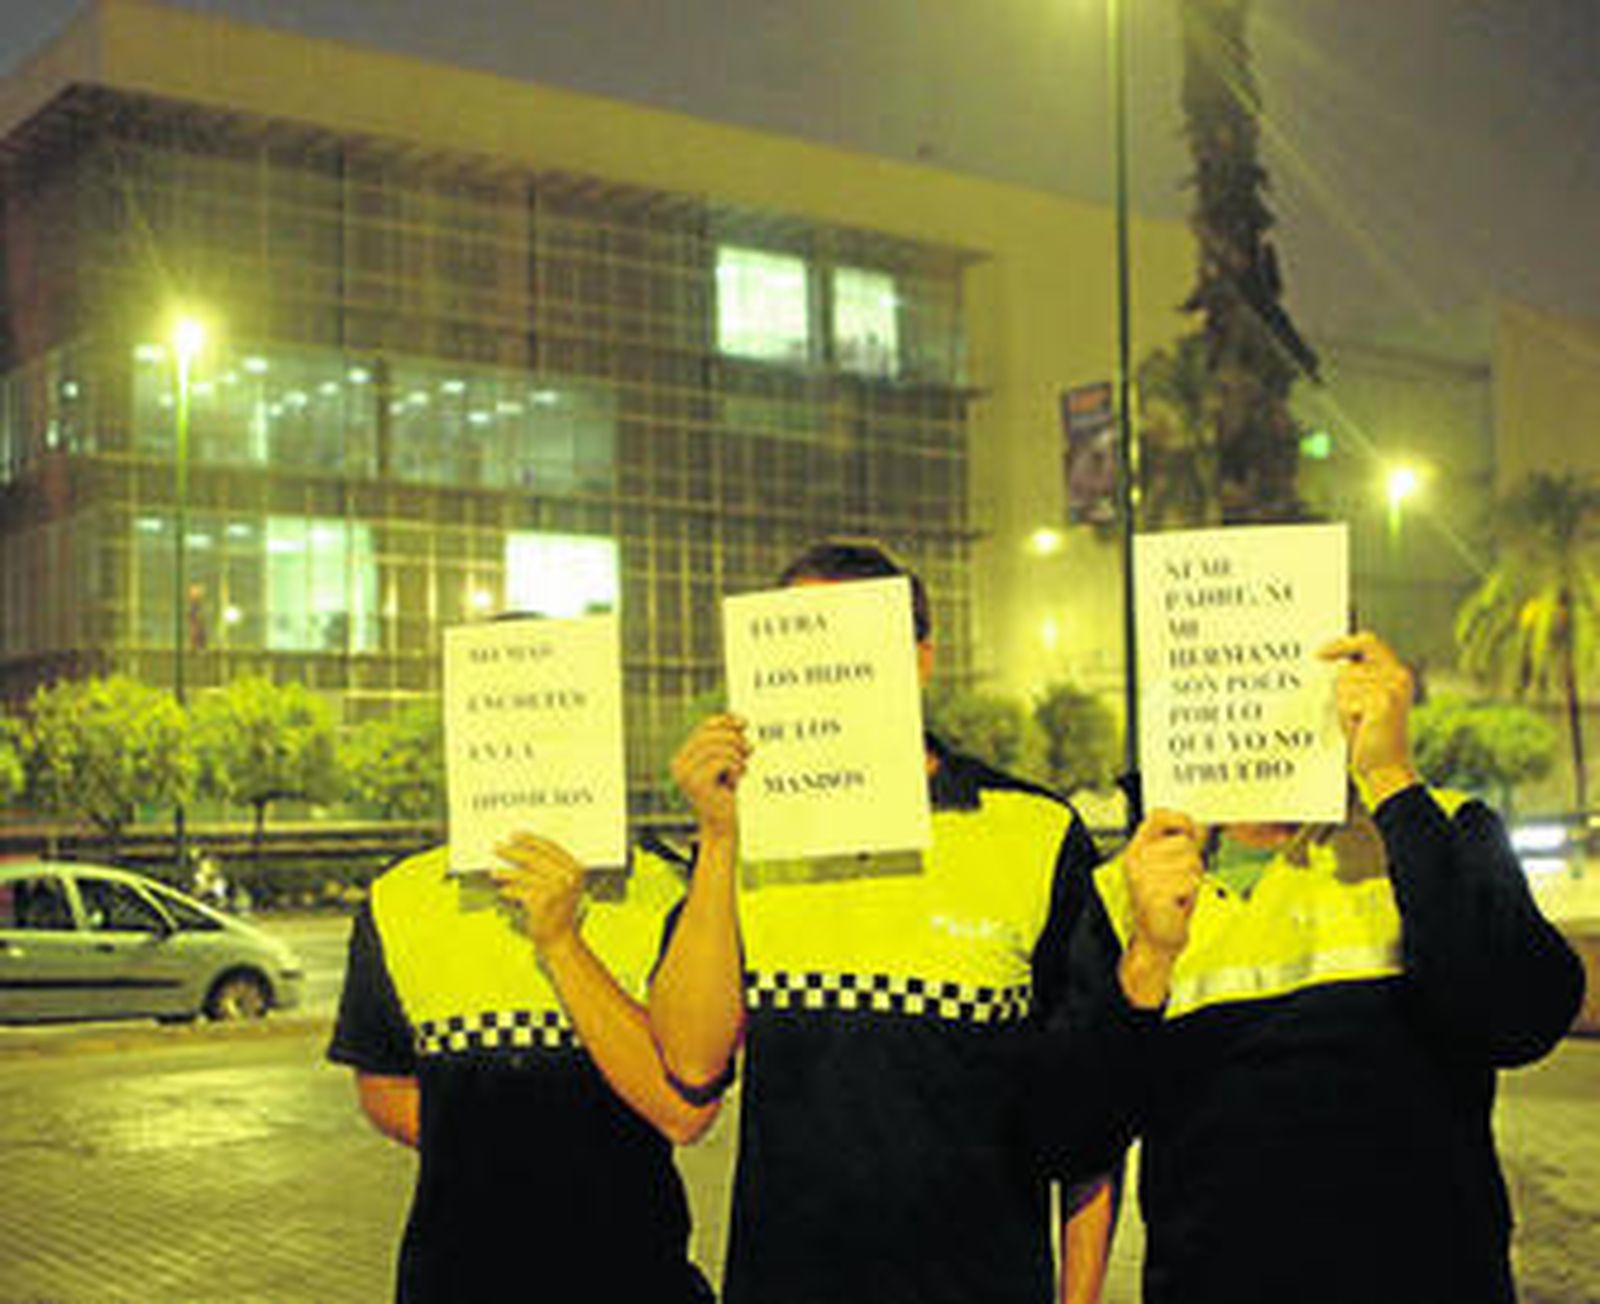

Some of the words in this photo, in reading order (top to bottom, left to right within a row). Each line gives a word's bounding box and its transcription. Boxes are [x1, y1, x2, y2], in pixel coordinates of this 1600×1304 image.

[1168, 641, 1302, 669] HERMANO
[1226, 730, 1268, 752] YO
[1274, 728, 1314, 748] NO
